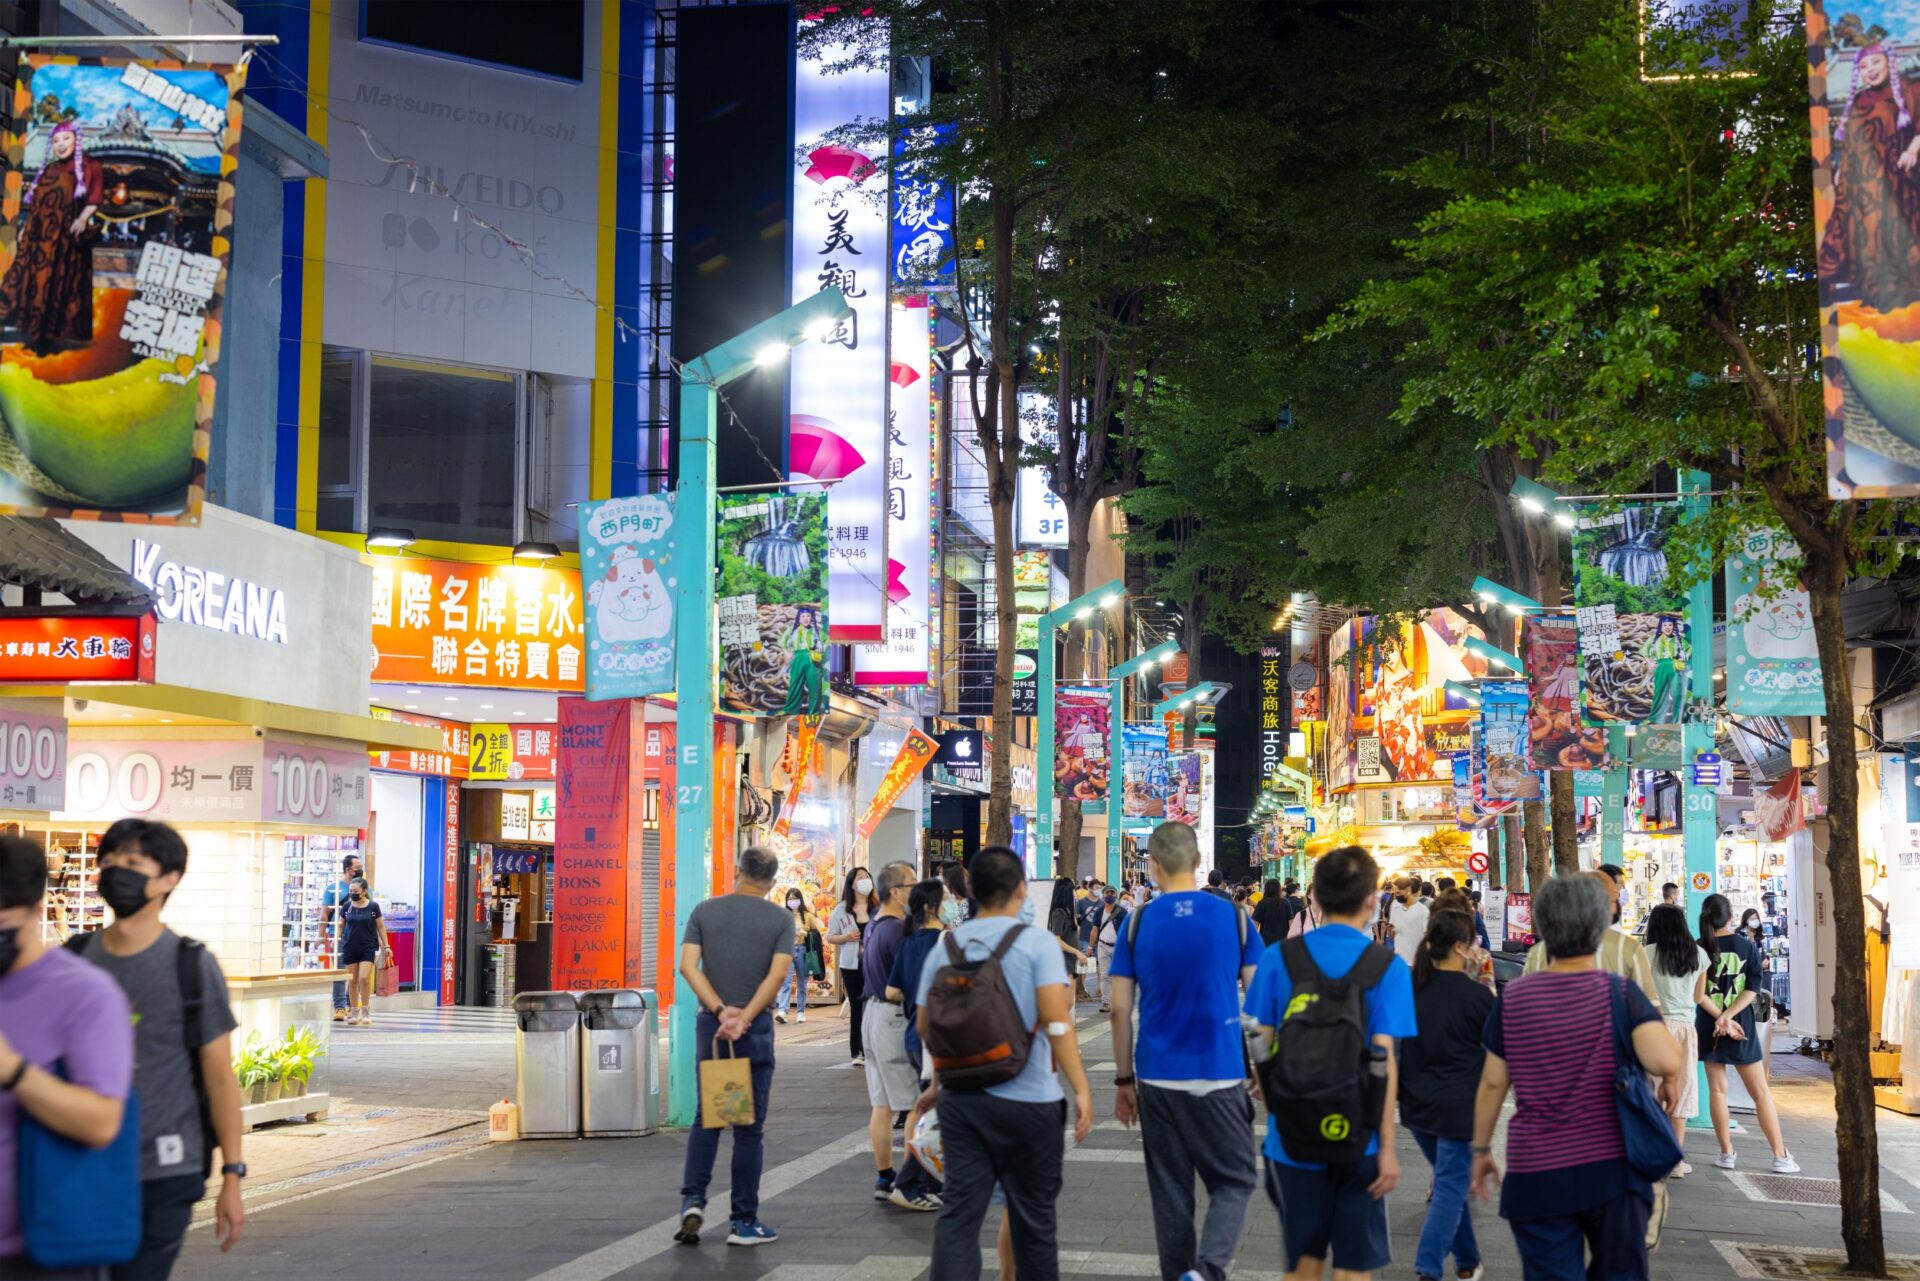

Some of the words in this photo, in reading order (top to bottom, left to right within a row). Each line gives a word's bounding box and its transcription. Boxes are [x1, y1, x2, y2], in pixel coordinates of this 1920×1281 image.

[355, 83, 492, 126] Matsumoto
[365, 155, 565, 214] SHISEIDO
[132, 342, 178, 364] JAPAN
[600, 514, 664, 538] 西門町
[1039, 518, 1065, 534] 3F
[133, 538, 289, 645] KOREANA
[890, 627, 917, 640] 料理
[52, 635, 132, 659] 大車輪
[865, 644, 891, 654] SINCE
[893, 644, 915, 654] 1946
[432, 634, 581, 681] 聯合特賣會
[1262, 660, 1280, 729] 沃客商旅
[562, 725, 605, 736] MONT
[562, 737, 606, 748] BLANC
[645, 730, 661, 757] 品
[472, 733, 487, 773] 2
[683, 745, 698, 764] E
[170, 765, 255, 792] 均一價
[271, 752, 329, 818] 100
[332, 772, 366, 801] 均一價
[3, 783, 37, 805] 均一價
[678, 785, 703, 804] 27
[1608, 794, 1619, 807] E
[1687, 794, 1713, 812] 30
[1040, 813, 1049, 824] E
[1111, 828, 1118, 837] E
[1604, 822, 1623, 835] 28
[1038, 834, 1051, 844] 25
[562, 858, 623, 869] CHANEL
[558, 875, 602, 889] BOSS
